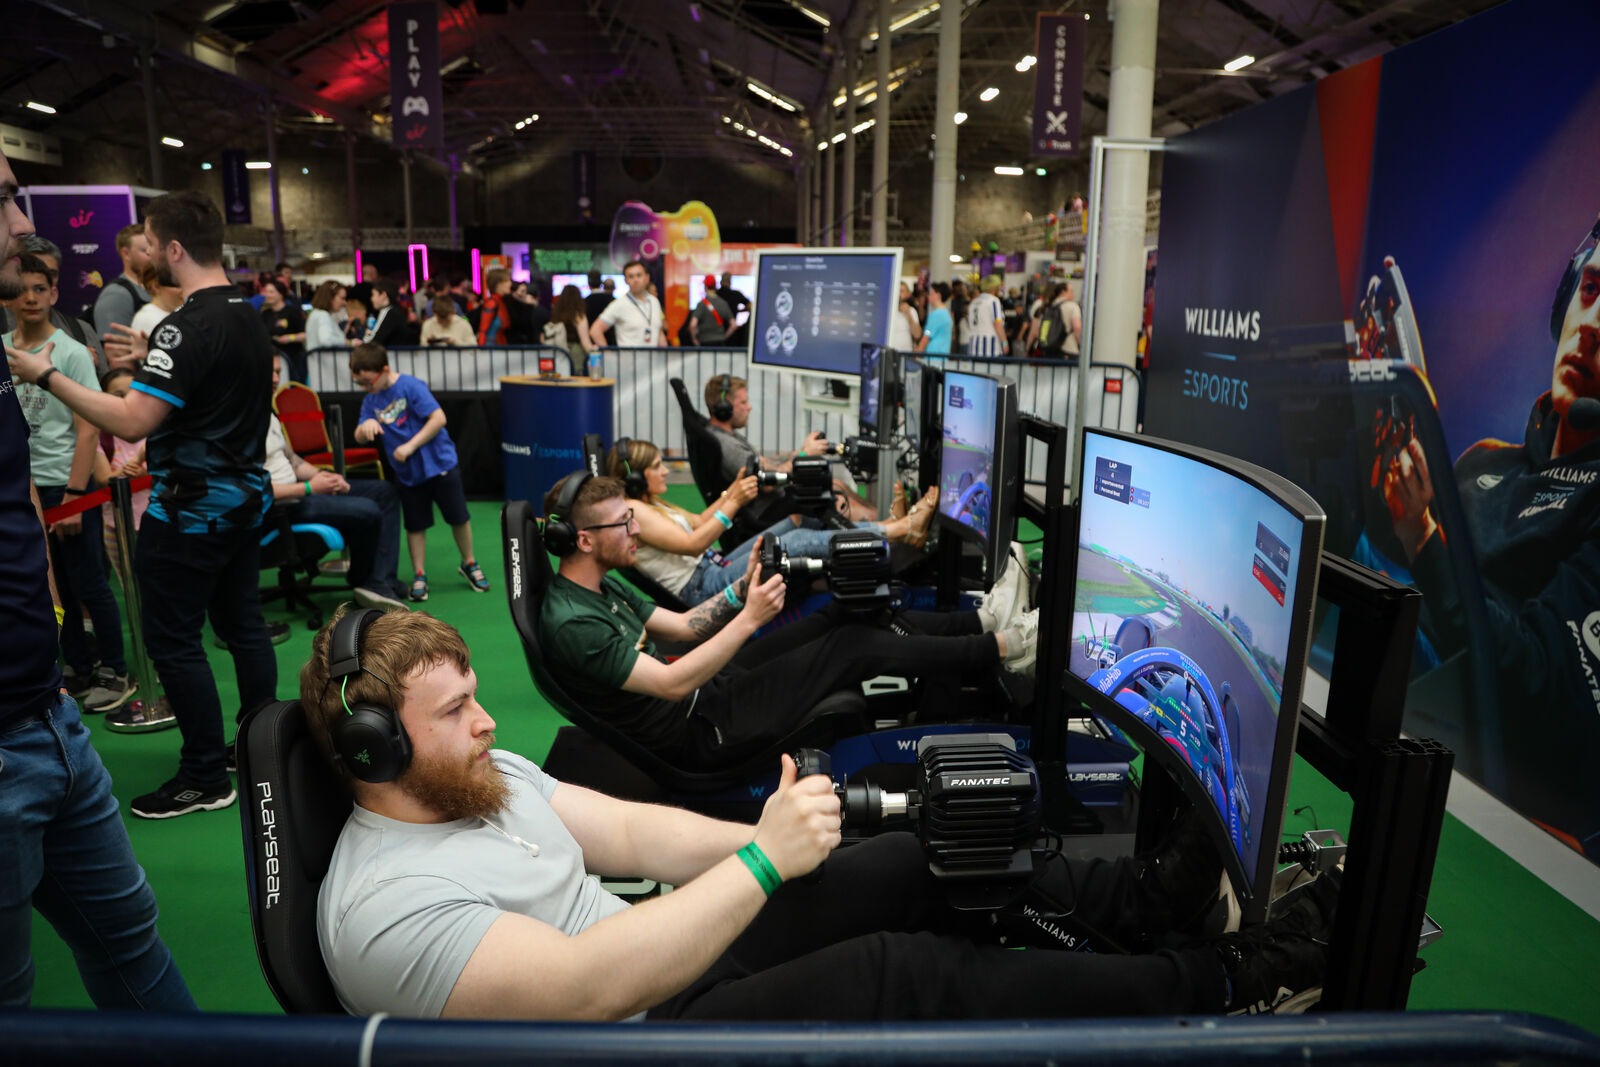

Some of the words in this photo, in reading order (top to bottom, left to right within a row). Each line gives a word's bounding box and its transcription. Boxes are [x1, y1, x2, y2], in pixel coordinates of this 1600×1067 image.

[406, 18, 421, 88] PLAY
[1053, 24, 1067, 107] COMPETE
[1185, 307, 1261, 342] WILLIAMS
[1183, 368, 1249, 411] ESPORTS
[839, 541, 874, 549] FANATEC
[1096, 667, 1122, 694] uliaHub
[1180, 719, 1187, 737] 5
[950, 777, 1011, 786] FANATEC
[1023, 904, 1077, 948] WILLIAMS
